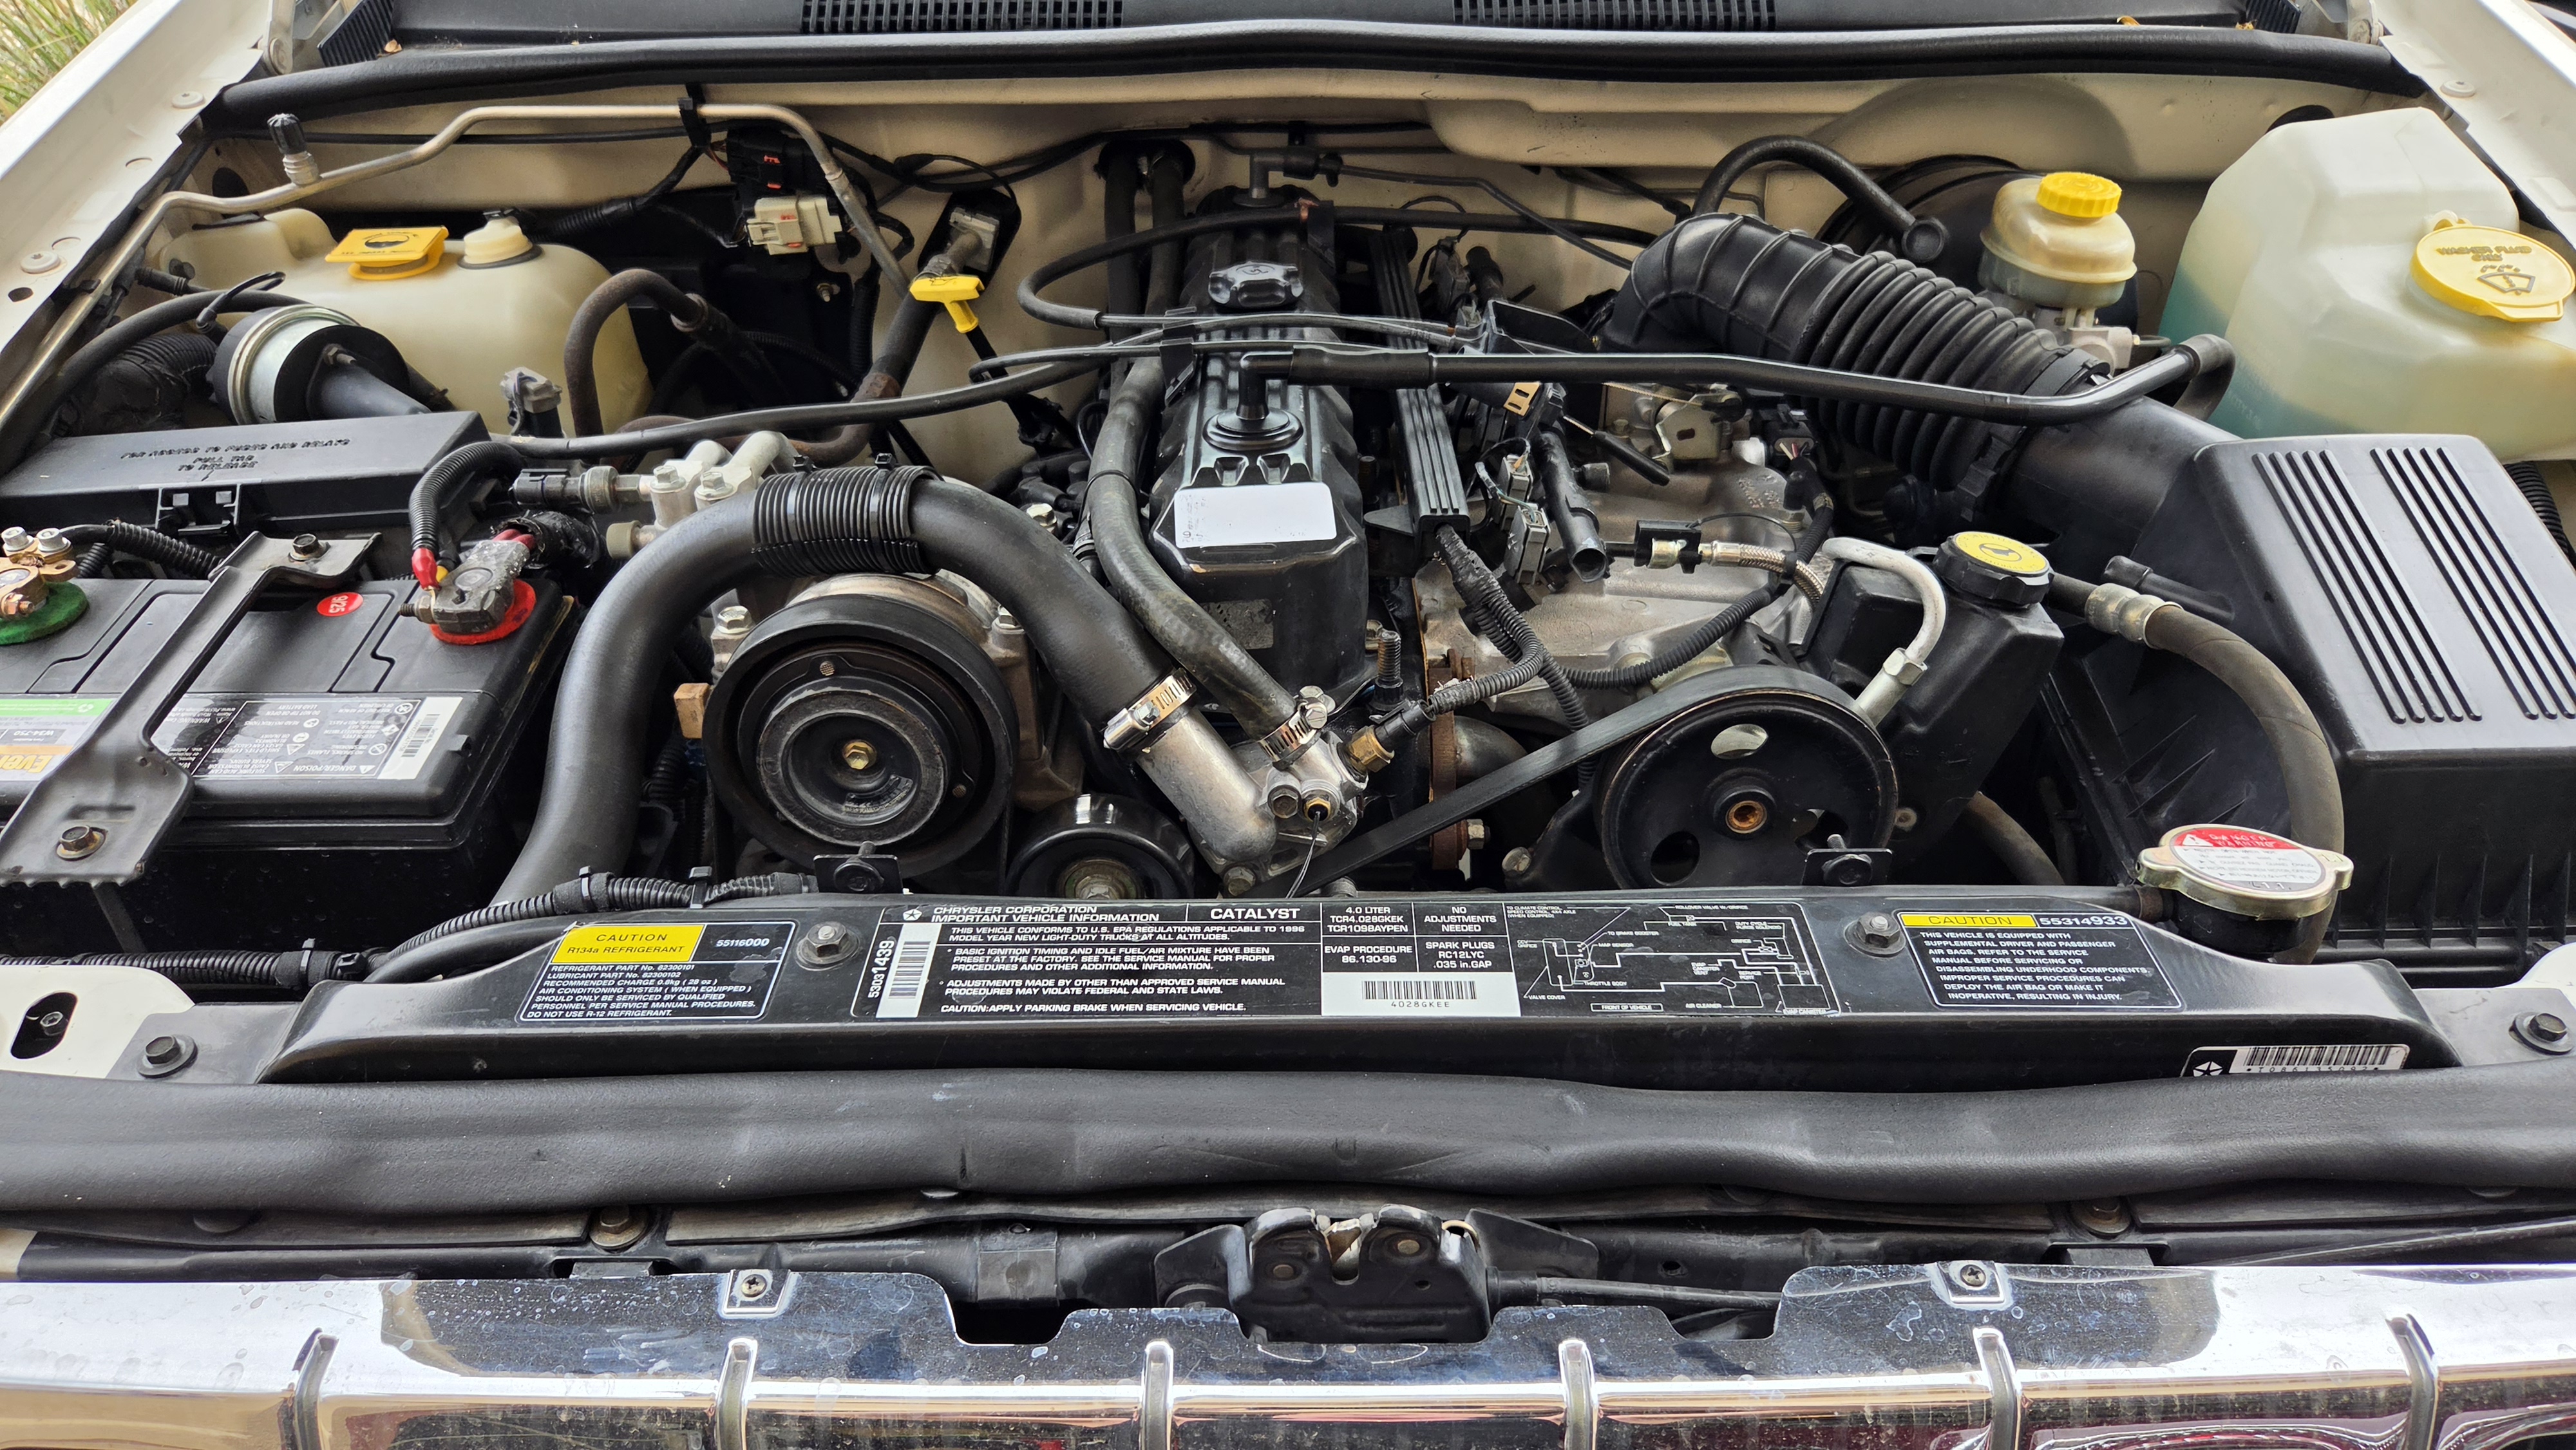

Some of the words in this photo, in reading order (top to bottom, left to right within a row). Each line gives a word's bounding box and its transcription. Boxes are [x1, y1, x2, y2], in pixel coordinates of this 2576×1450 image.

[328, 595, 348, 614] 9/25
[1211, 908, 1300, 919] CATALYST
[931, 914, 1009, 923] IMPORTANT
[1069, 914, 1159, 922] INFORMATION
[1928, 916, 2012, 925] CAUTION
[2040, 917, 2128, 926] 55314933
[716, 938, 770, 946] 55116000
[987, 948, 1030, 956] IGNITION
[867, 940, 895, 998] 53031439
